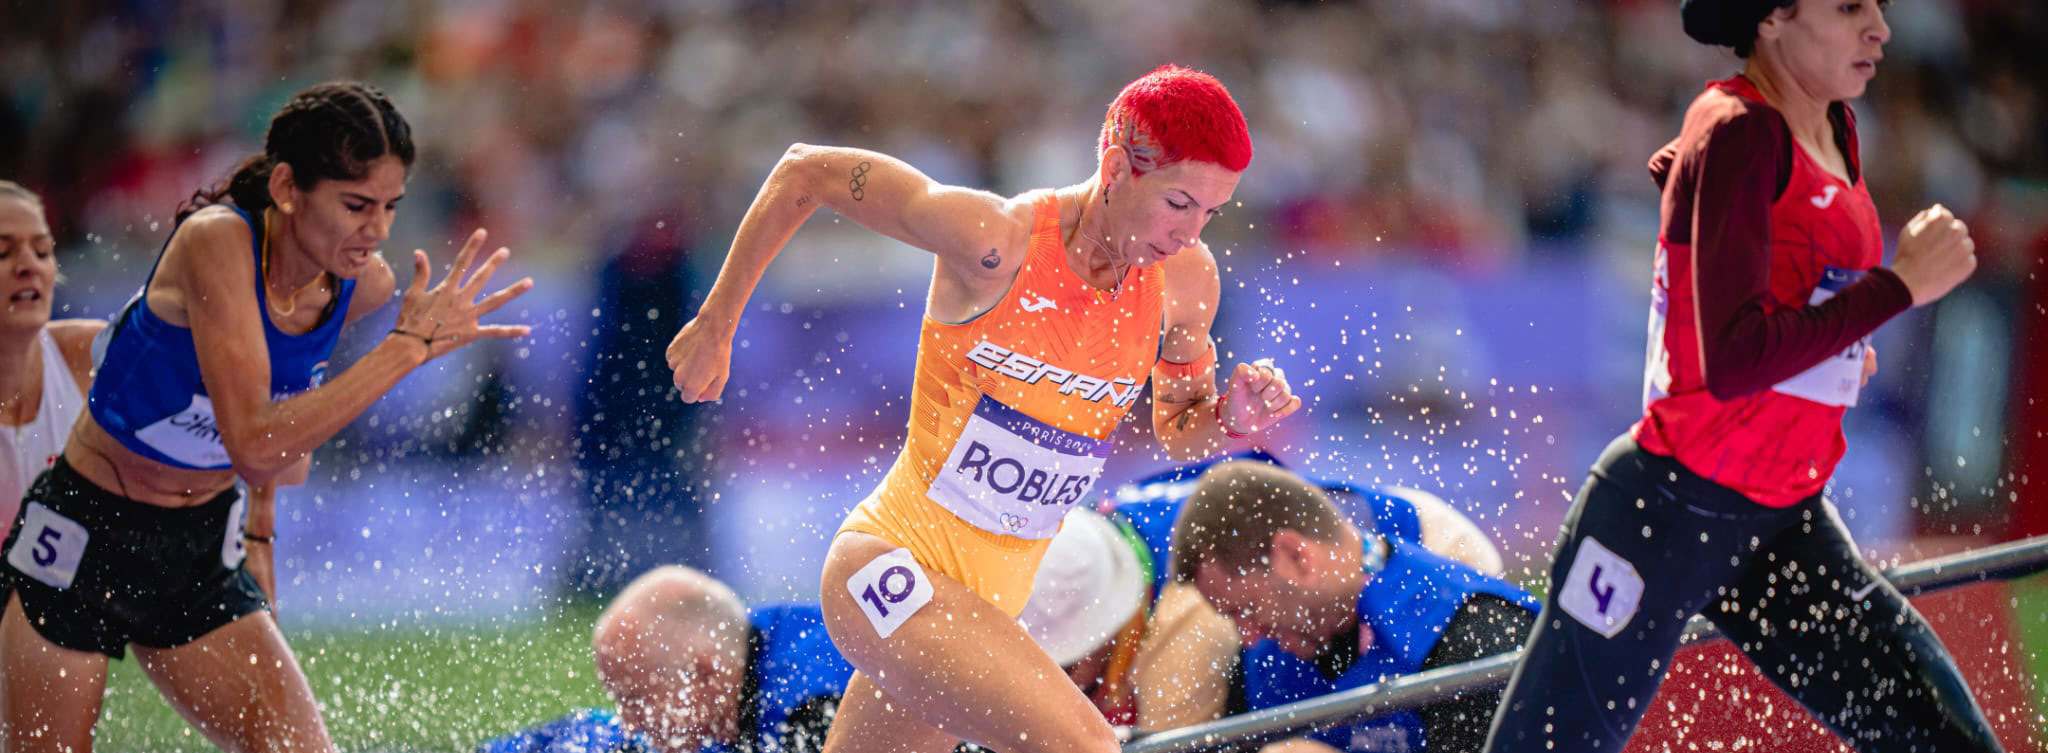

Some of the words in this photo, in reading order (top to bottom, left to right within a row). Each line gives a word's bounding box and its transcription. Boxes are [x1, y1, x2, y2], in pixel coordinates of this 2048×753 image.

[1021, 421, 1062, 446] PARIS
[956, 440, 1090, 506] ROBLES
[32, 525, 62, 567] 5
[862, 565, 916, 618] 10
[1589, 564, 1615, 615] 4
